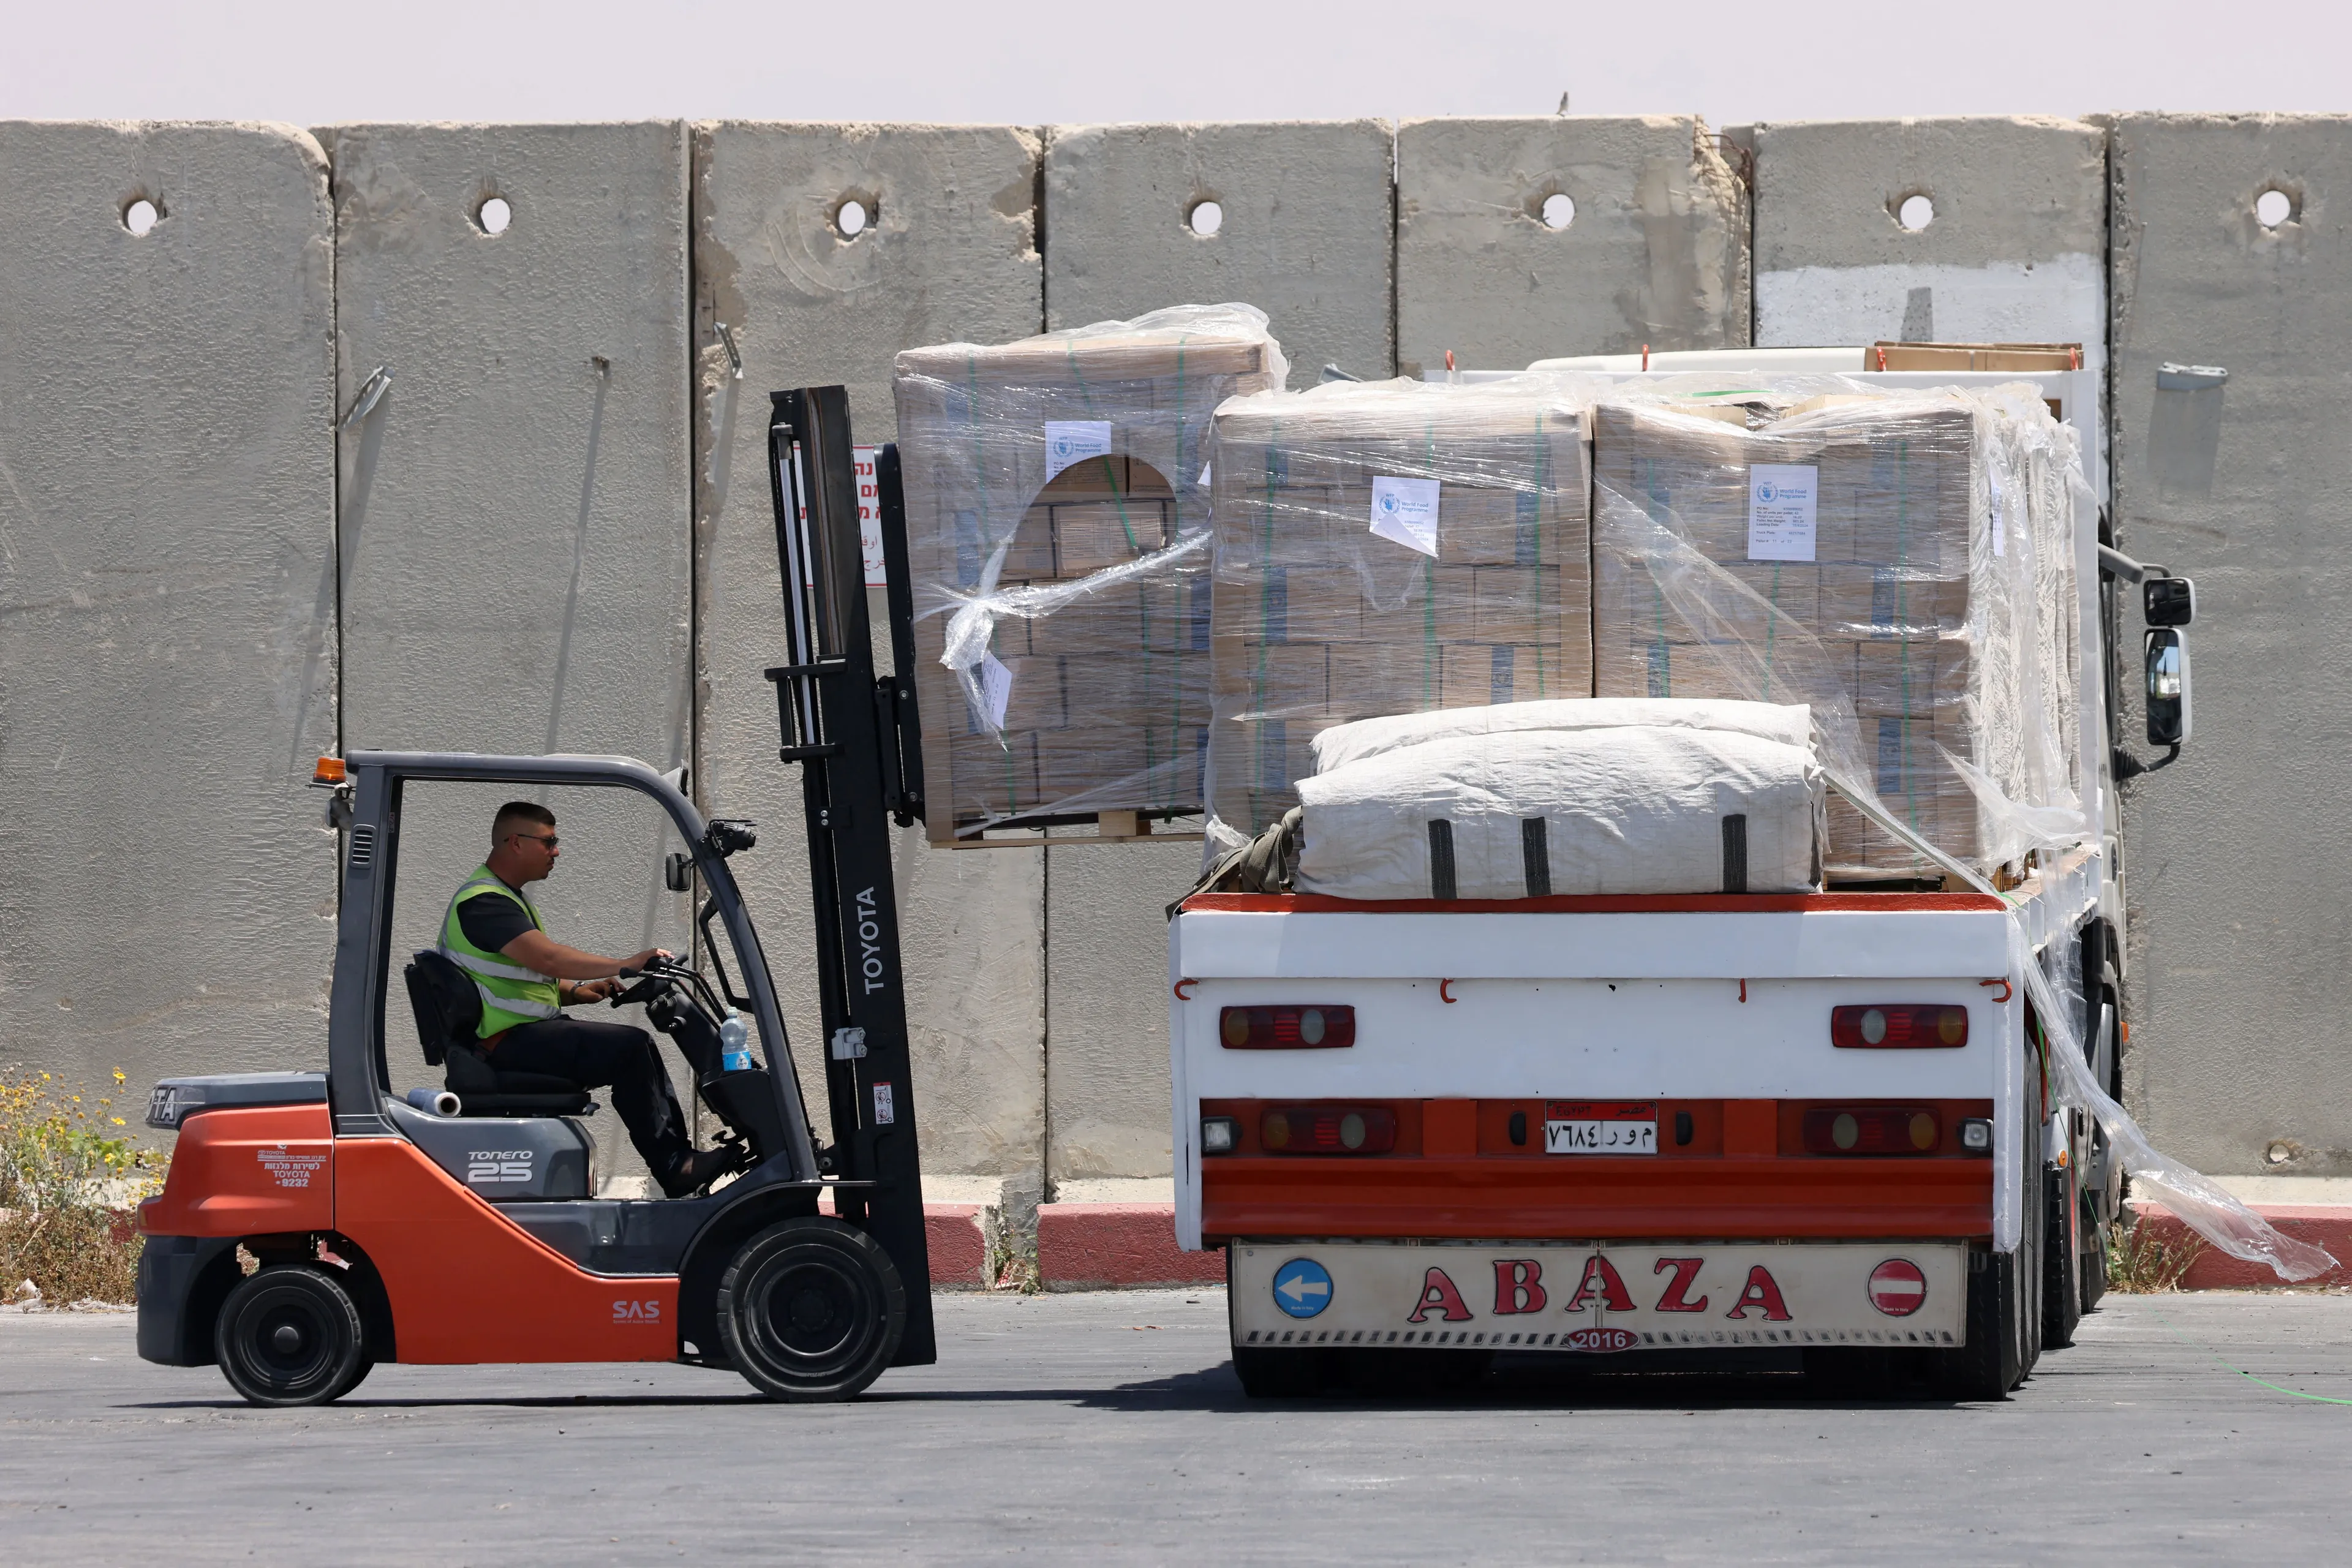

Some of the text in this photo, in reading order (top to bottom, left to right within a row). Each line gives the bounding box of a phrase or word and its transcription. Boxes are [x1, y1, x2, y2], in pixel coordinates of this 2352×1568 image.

[856, 886, 884, 995] TOYOTA
[1556, 1106, 1591, 1116] EGYPT
[1615, 1106, 1646, 1117] مصر
[468, 1151, 533, 1161] TONERO
[468, 1162, 533, 1183] 25
[1406, 1256, 1794, 1323] ABAZA
[612, 1300, 660, 1318] SAS
[1575, 1332, 1627, 1348] 2016
